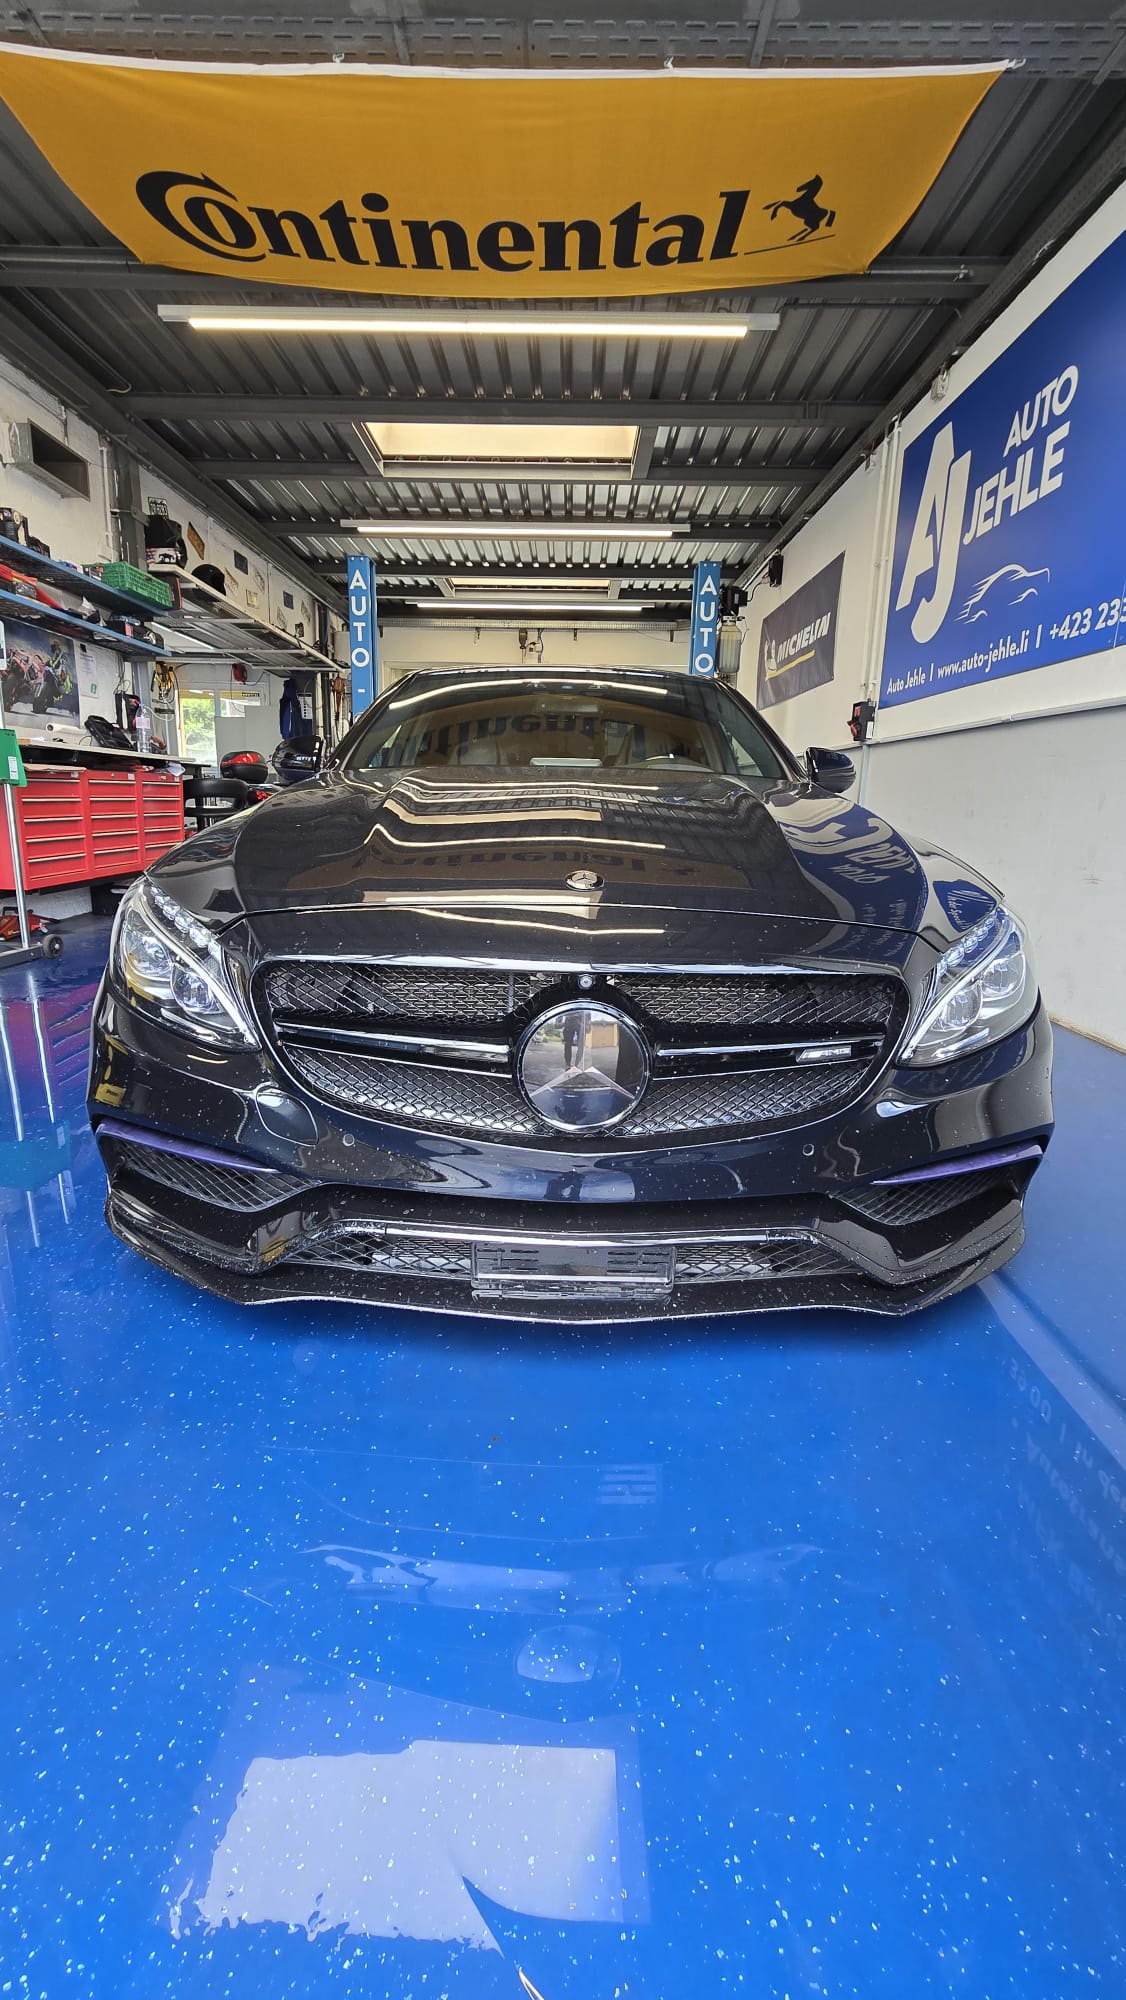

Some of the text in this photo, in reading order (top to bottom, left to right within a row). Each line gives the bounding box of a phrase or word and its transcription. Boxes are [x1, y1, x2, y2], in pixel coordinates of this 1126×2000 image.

[136, 171, 750, 272] Continental
[1003, 364, 1079, 458] AUTO
[896, 421, 972, 644] AJ
[962, 420, 1071, 546] JEHLE
[349, 569, 370, 668] AUTO
[694, 574, 717, 673] AUTO
[776, 611, 832, 664] MICHELIN
[886, 676, 905, 695] Auto
[905, 666, 926, 689] Jehle
[937, 629, 1030, 674] www.auto-jehle.li
[1049, 606, 1093, 641] +423
